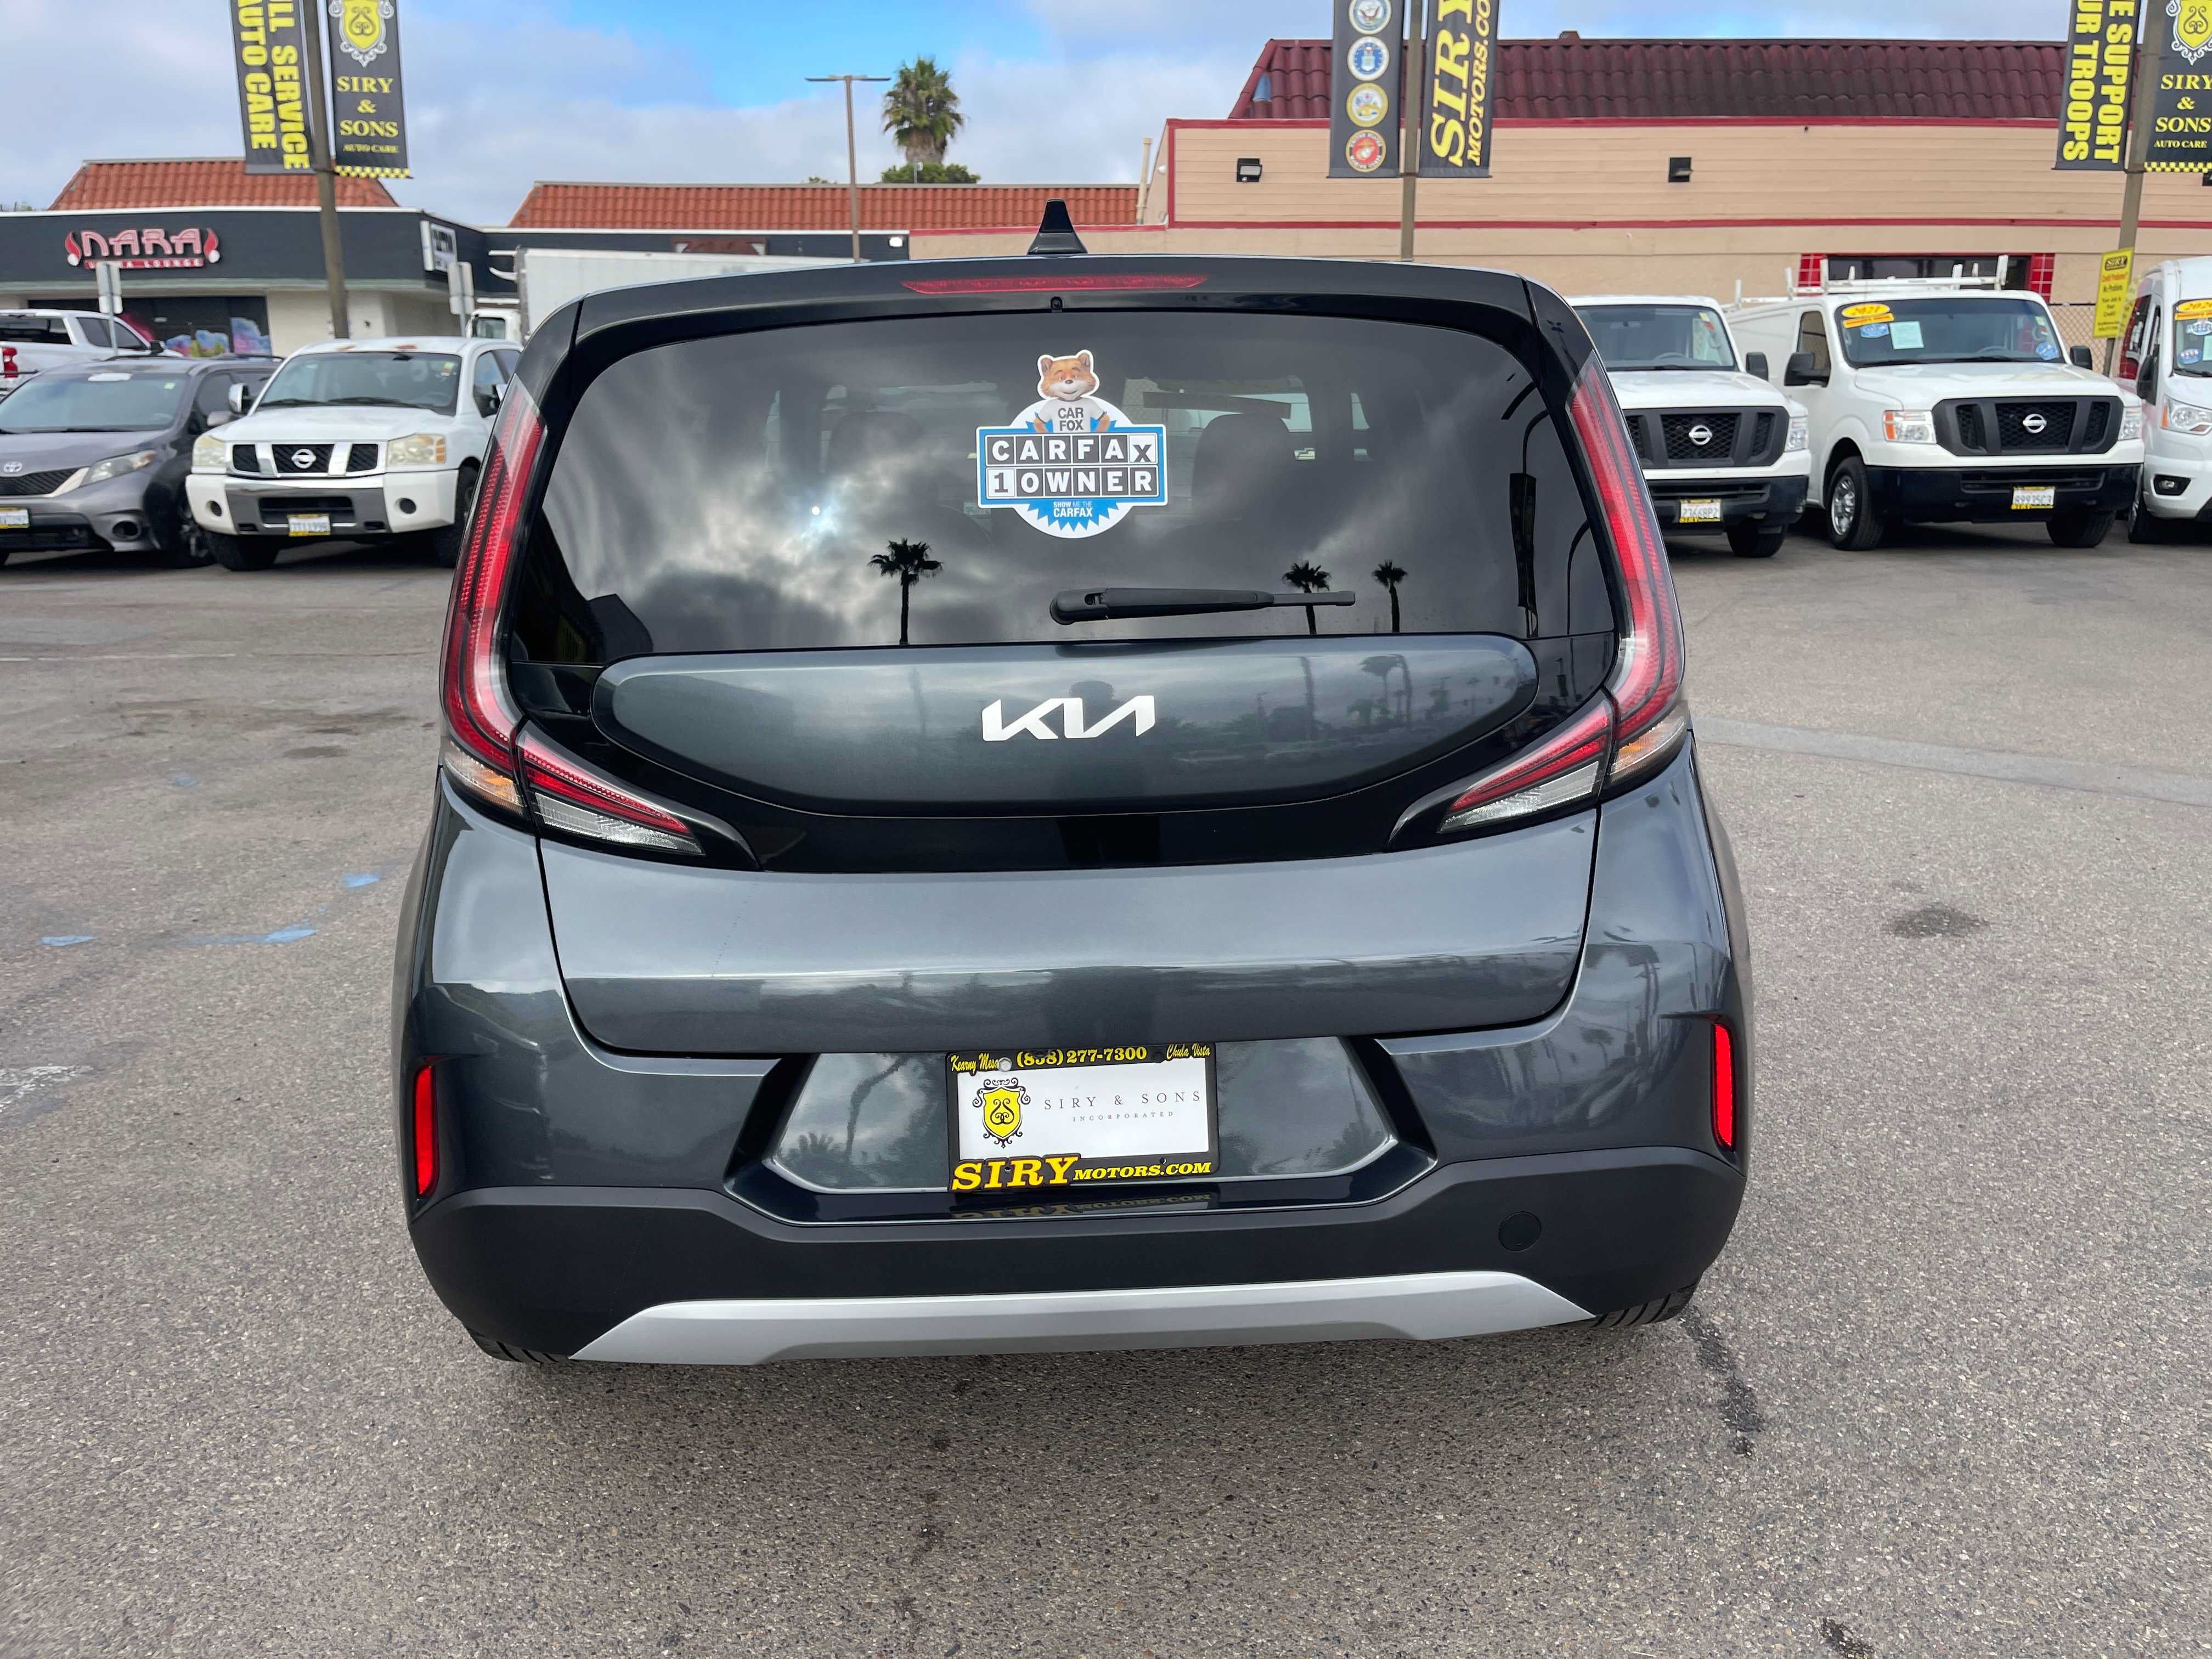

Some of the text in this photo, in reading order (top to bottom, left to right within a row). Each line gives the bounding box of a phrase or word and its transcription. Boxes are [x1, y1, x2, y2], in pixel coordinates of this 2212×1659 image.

[268, 0, 310, 170] LL SERVICE
[337, 76, 393, 93] SIRY
[1467, 0, 1491, 166] MOTORS.CO
[2063, 0, 2103, 161] UR TROOPS
[2094, 0, 2136, 163] E SUPPORT
[2160, 74, 2212, 91] SIRY
[245, 72, 277, 150] CARE
[358, 99, 377, 114] &
[2177, 97, 2195, 110] &
[340, 119, 399, 138] SONS
[2155, 116, 2212, 133] SONS
[343, 144, 399, 154] AUTO CARE
[2181, 140, 2208, 149] CARE
[81, 228, 202, 257] NARA
[1058, 408, 1084, 419] CAR
[1059, 420, 1084, 431] FOX
[992, 439, 1152, 462] CARFAX
[1053, 507, 1093, 518] CARFAX
[951, 1054, 977, 1074] Kearny
[1066, 1047, 1147, 1063] 277-7300
[1166, 1044, 1189, 1059] Chula
[1192, 1043, 1210, 1057] Vista
[1044, 1091, 1200, 1110] SIRY & SONS
[1073, 1111, 1173, 1122] INCORPORATED
[952, 1156, 1211, 1190] SIRY MOTORS.COM
